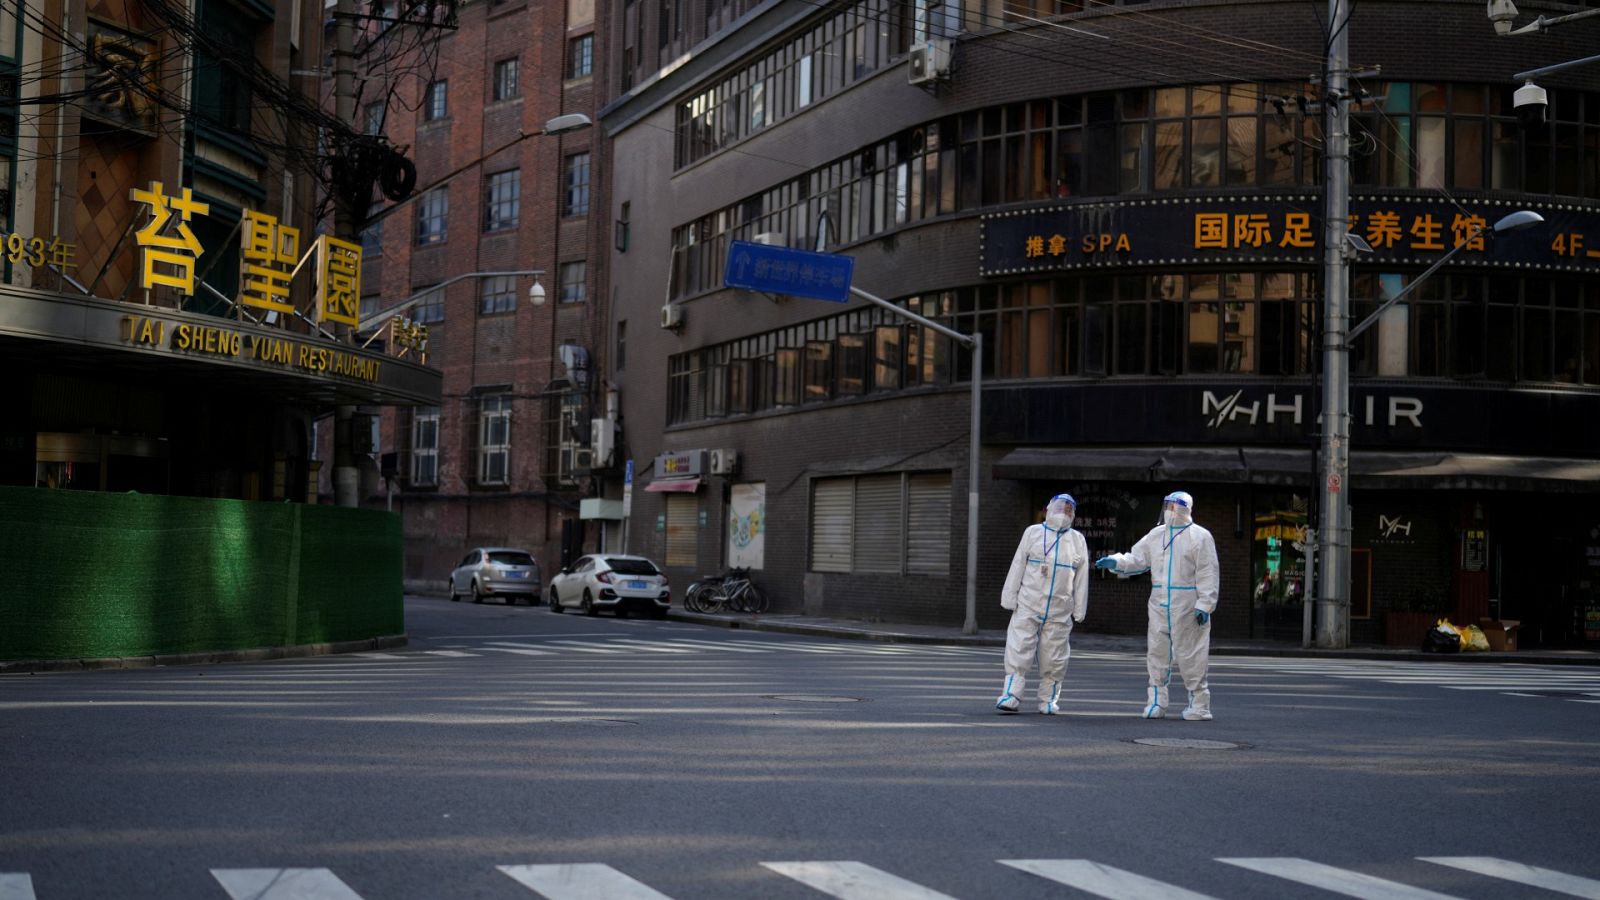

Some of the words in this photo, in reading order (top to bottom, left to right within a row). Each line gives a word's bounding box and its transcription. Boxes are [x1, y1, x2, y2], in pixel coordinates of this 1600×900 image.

[1026, 234, 1067, 258] 推拿
[1082, 233, 1132, 255] SPA
[1194, 210, 1488, 253] 国际足养生馆
[1551, 232, 1600, 259] 4F
[0, 233, 78, 273] 93年
[127, 316, 164, 345] TAI
[178, 323, 241, 357] SHENG
[250, 336, 294, 364] YUAN
[299, 345, 382, 382] RESTAURANT
[1266, 393, 1424, 428] HIR
